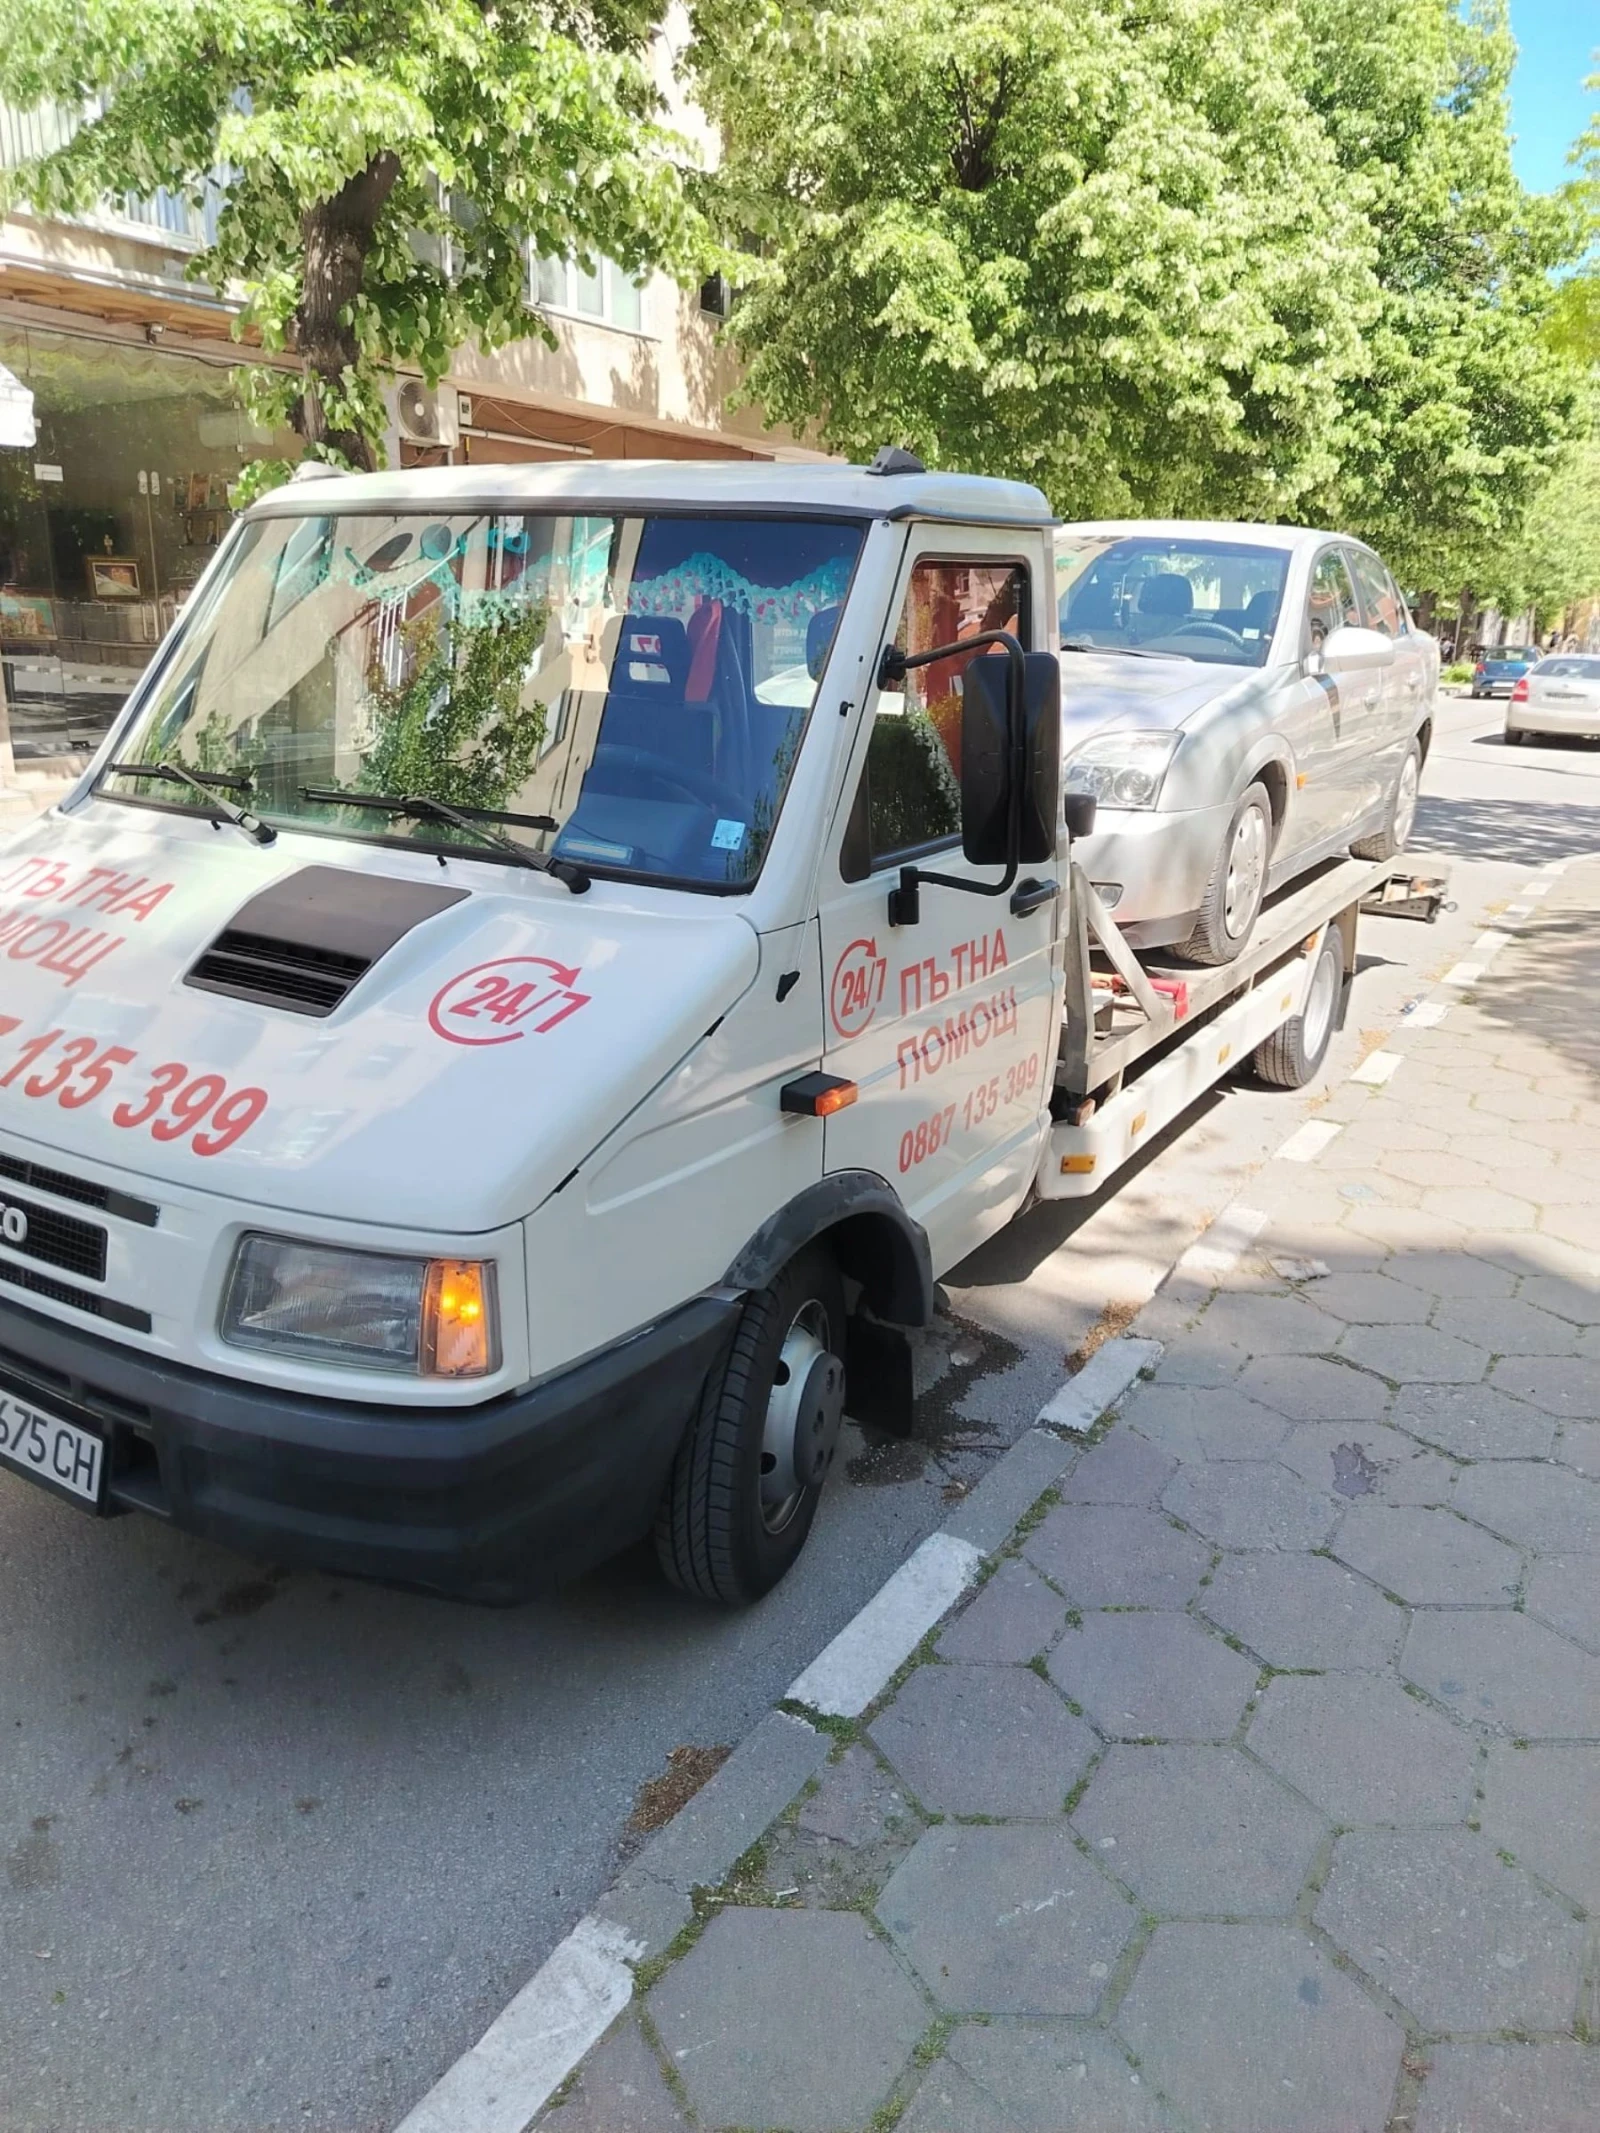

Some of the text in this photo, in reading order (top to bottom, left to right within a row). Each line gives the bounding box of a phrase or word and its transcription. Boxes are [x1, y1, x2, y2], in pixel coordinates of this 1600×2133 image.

[0, 857, 175, 922] ПЪТНА
[0, 907, 127, 988] МОЩ
[840, 957, 888, 1018] 24/7
[900, 927, 1009, 1017] ПЪТНА
[448, 975, 592, 1033] 24/7
[897, 985, 1018, 1091] ПОМОЩ
[0, 1028, 269, 1156] 135 399
[900, 1052, 1039, 1173] 0887 135 399
[53, 1429, 96, 1492] CH
